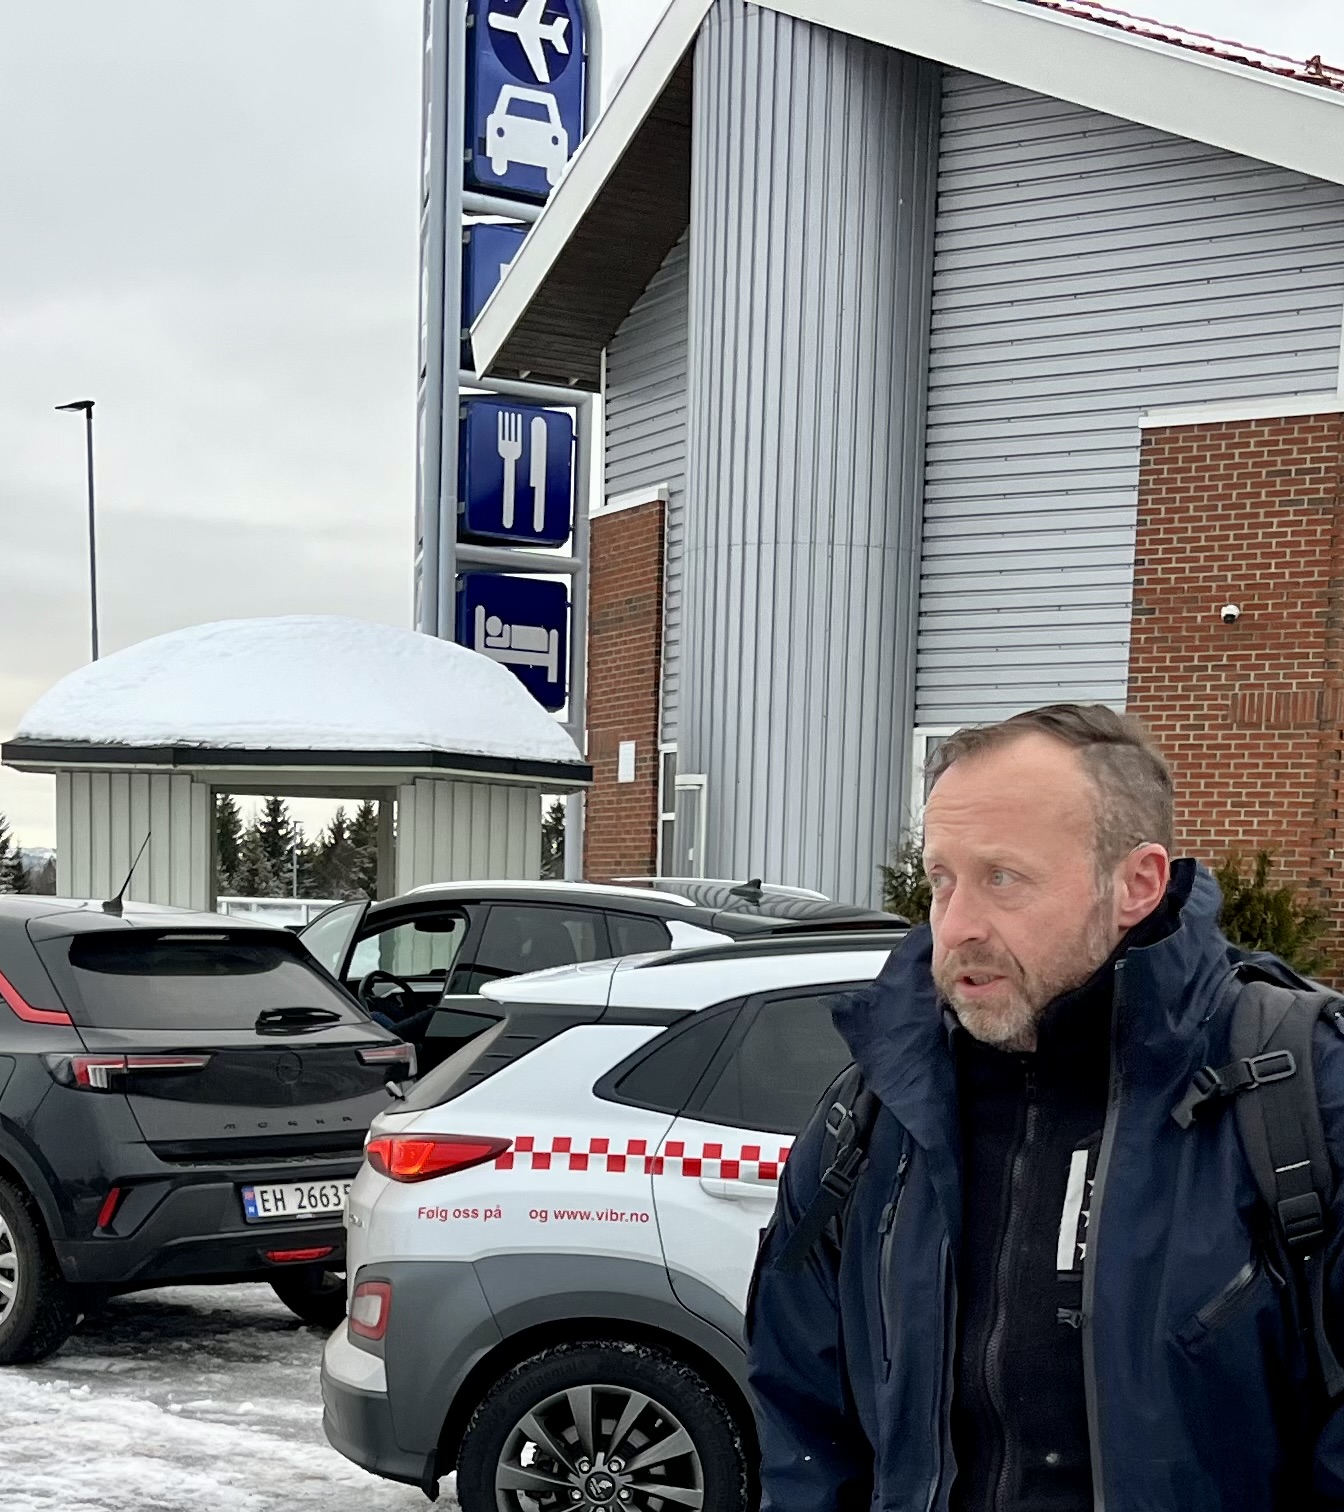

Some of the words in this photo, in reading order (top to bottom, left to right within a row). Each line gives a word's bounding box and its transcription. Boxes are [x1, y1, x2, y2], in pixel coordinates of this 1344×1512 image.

[260, 1188, 287, 1213] EH
[417, 1206, 449, 1222] Følg
[452, 1208, 479, 1219] oss
[483, 1204, 502, 1222] på
[528, 1209, 549, 1223] og
[553, 1208, 650, 1223] www.vibr.no
